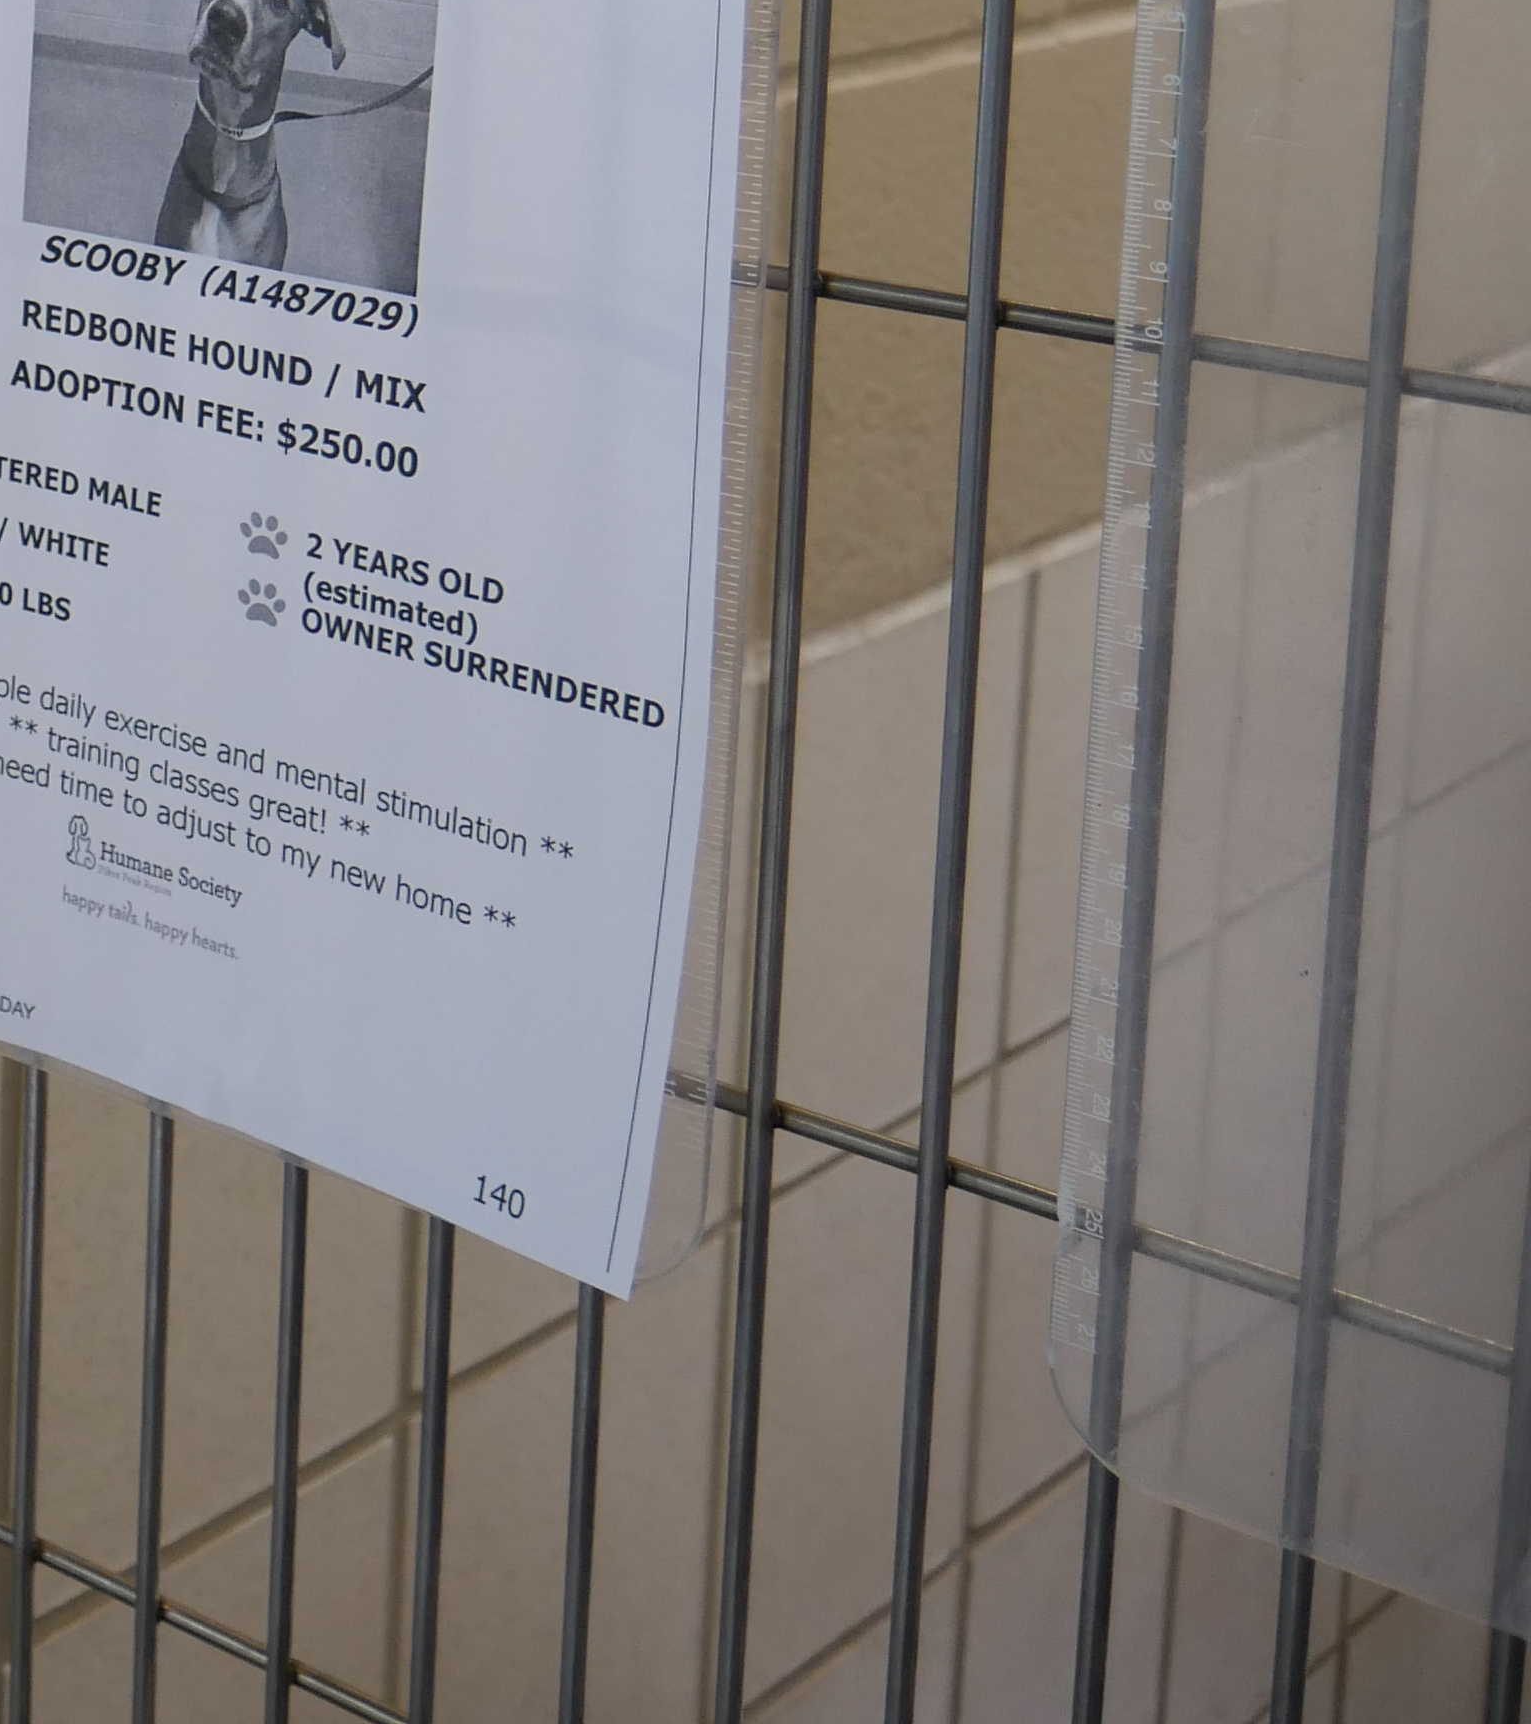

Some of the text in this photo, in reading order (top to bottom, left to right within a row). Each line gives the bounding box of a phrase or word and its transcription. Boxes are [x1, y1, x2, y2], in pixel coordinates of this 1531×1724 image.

[39, 235, 419, 339] SCOOBY (A1487029)
[21, 298, 177, 359] REDBONE
[187, 333, 313, 387] HOUND
[354, 368, 428, 414] MIX
[1145, 318, 1164, 338] 10
[9, 359, 419, 478] ADOPTION FEE: $250.00
[87, 476, 163, 518] MALE
[18, 521, 111, 568] WHITE
[306, 532, 505, 605] 2 YEARS OLD
[21, 587, 72, 622] LBS
[303, 570, 478, 646] (estimated)
[301, 607, 666, 729] OWNER SURRENDERED
[39, 685, 97, 729] daily
[104, 709, 208, 758] exercise
[216, 742, 266, 775] and
[275, 760, 367, 806] mental
[375, 789, 527, 858] stimulation
[46, 726, 140, 782] training
[149, 759, 240, 808] classes
[248, 793, 327, 833] great!
[59, 769, 115, 808] time
[122, 788, 148, 818] to
[156, 804, 237, 848] adjust
[245, 827, 272, 857] to
[281, 843, 322, 879] my
[330, 858, 387, 895] new
[395, 873, 472, 926] home
[100, 841, 243, 908] Humane Society
[62, 884, 105, 918] happy
[144, 911, 189, 946] happy
[192, 927, 240, 960] hearts.
[0, 994, 37, 1020] DAY
[473, 1174, 526, 1220] 140
[1085, 1208, 1103, 1233] 25
